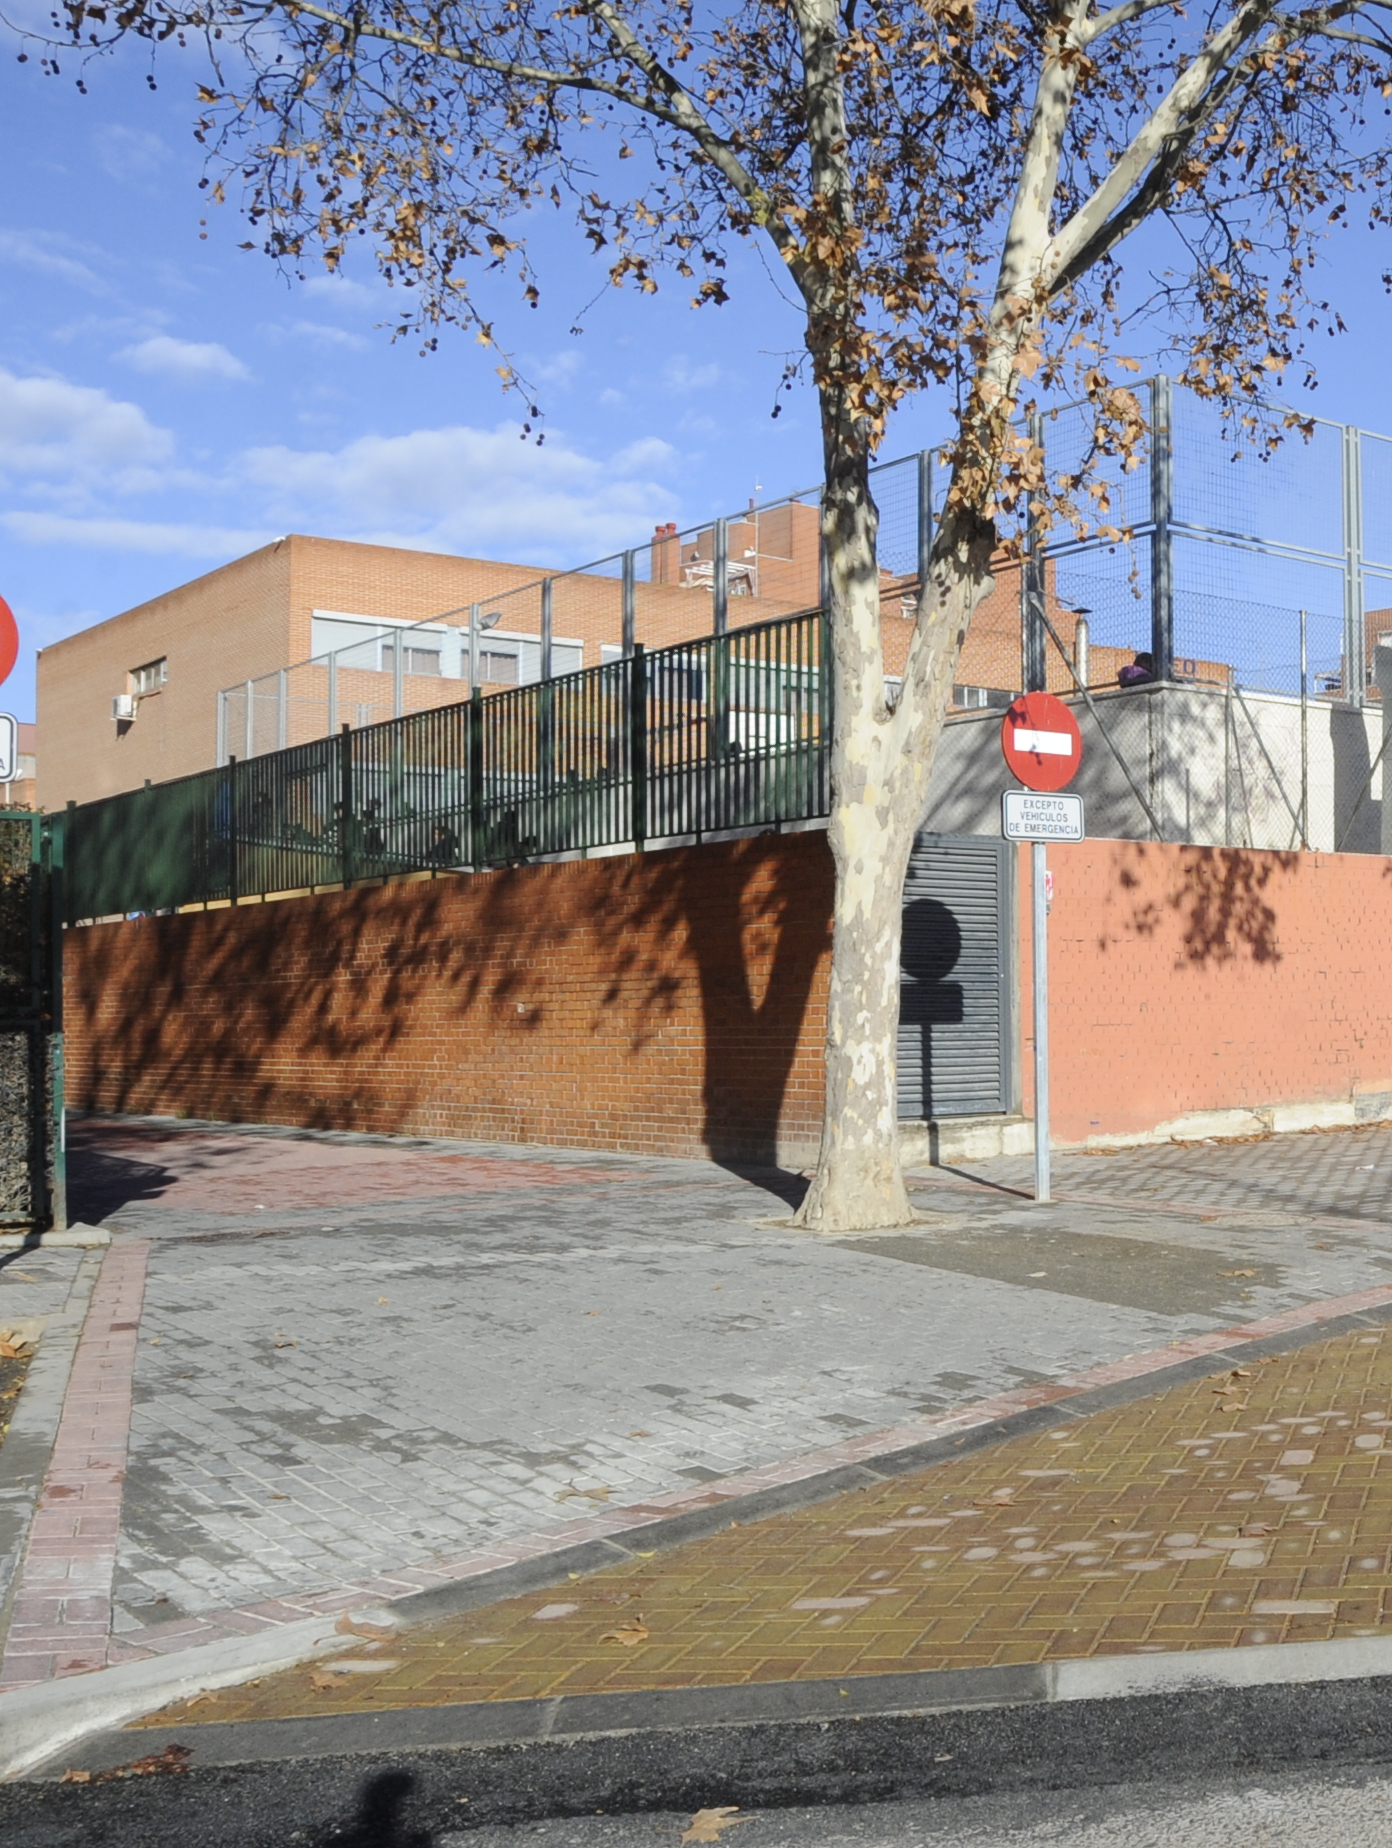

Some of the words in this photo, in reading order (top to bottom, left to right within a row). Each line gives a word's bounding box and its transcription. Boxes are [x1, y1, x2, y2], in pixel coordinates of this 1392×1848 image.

[1023, 799, 1064, 811] EXCEPTO
[1020, 811, 1069, 823] VEHICULOS
[1009, 822, 1020, 832] DE
[1024, 823, 1079, 835] EMERGENCIA
